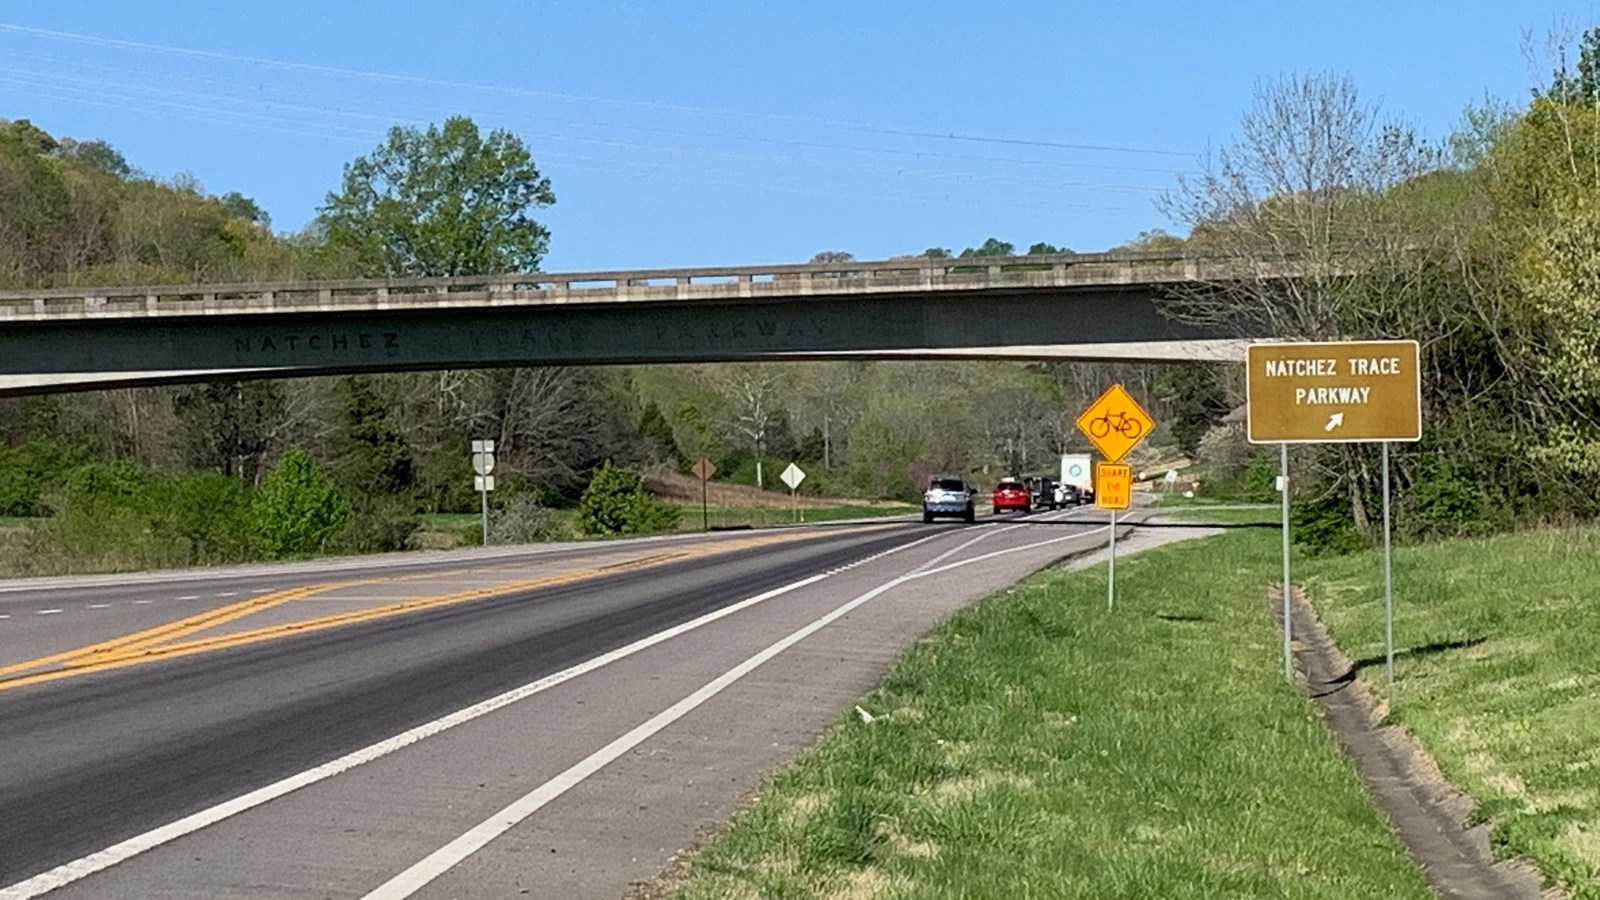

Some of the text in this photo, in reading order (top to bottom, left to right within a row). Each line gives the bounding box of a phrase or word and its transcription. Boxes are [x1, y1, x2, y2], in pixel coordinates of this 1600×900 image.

[234, 332, 399, 352] NATCHEZ
[1266, 358, 1401, 377] NATCHEZ TRACE
[1295, 387, 1371, 405] PARKWAY
[1101, 468, 1128, 478] SHARE
[1106, 481, 1121, 491] THE
[1102, 496, 1125, 505] ROAD
